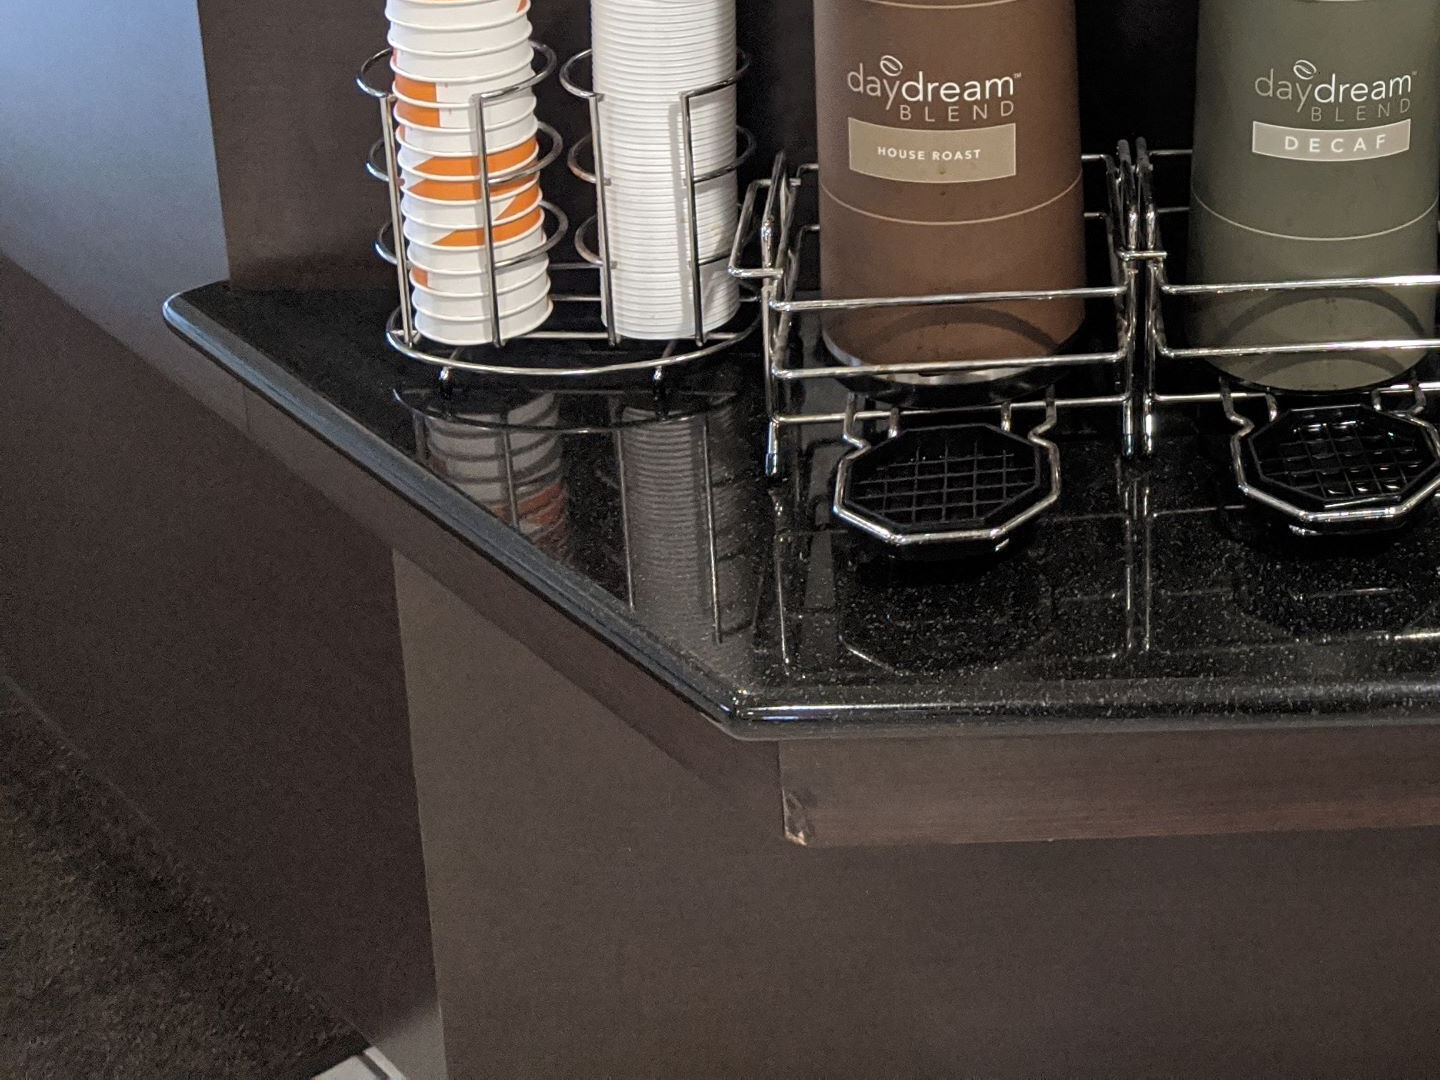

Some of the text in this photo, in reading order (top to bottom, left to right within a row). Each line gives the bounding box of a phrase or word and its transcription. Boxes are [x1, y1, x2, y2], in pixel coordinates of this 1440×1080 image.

[899, 100, 1014, 122] BLEND
[1311, 98, 1411, 122] BLEND
[877, 146, 981, 161] HOUSE ROAST
[1284, 133, 1386, 153] DECAF
